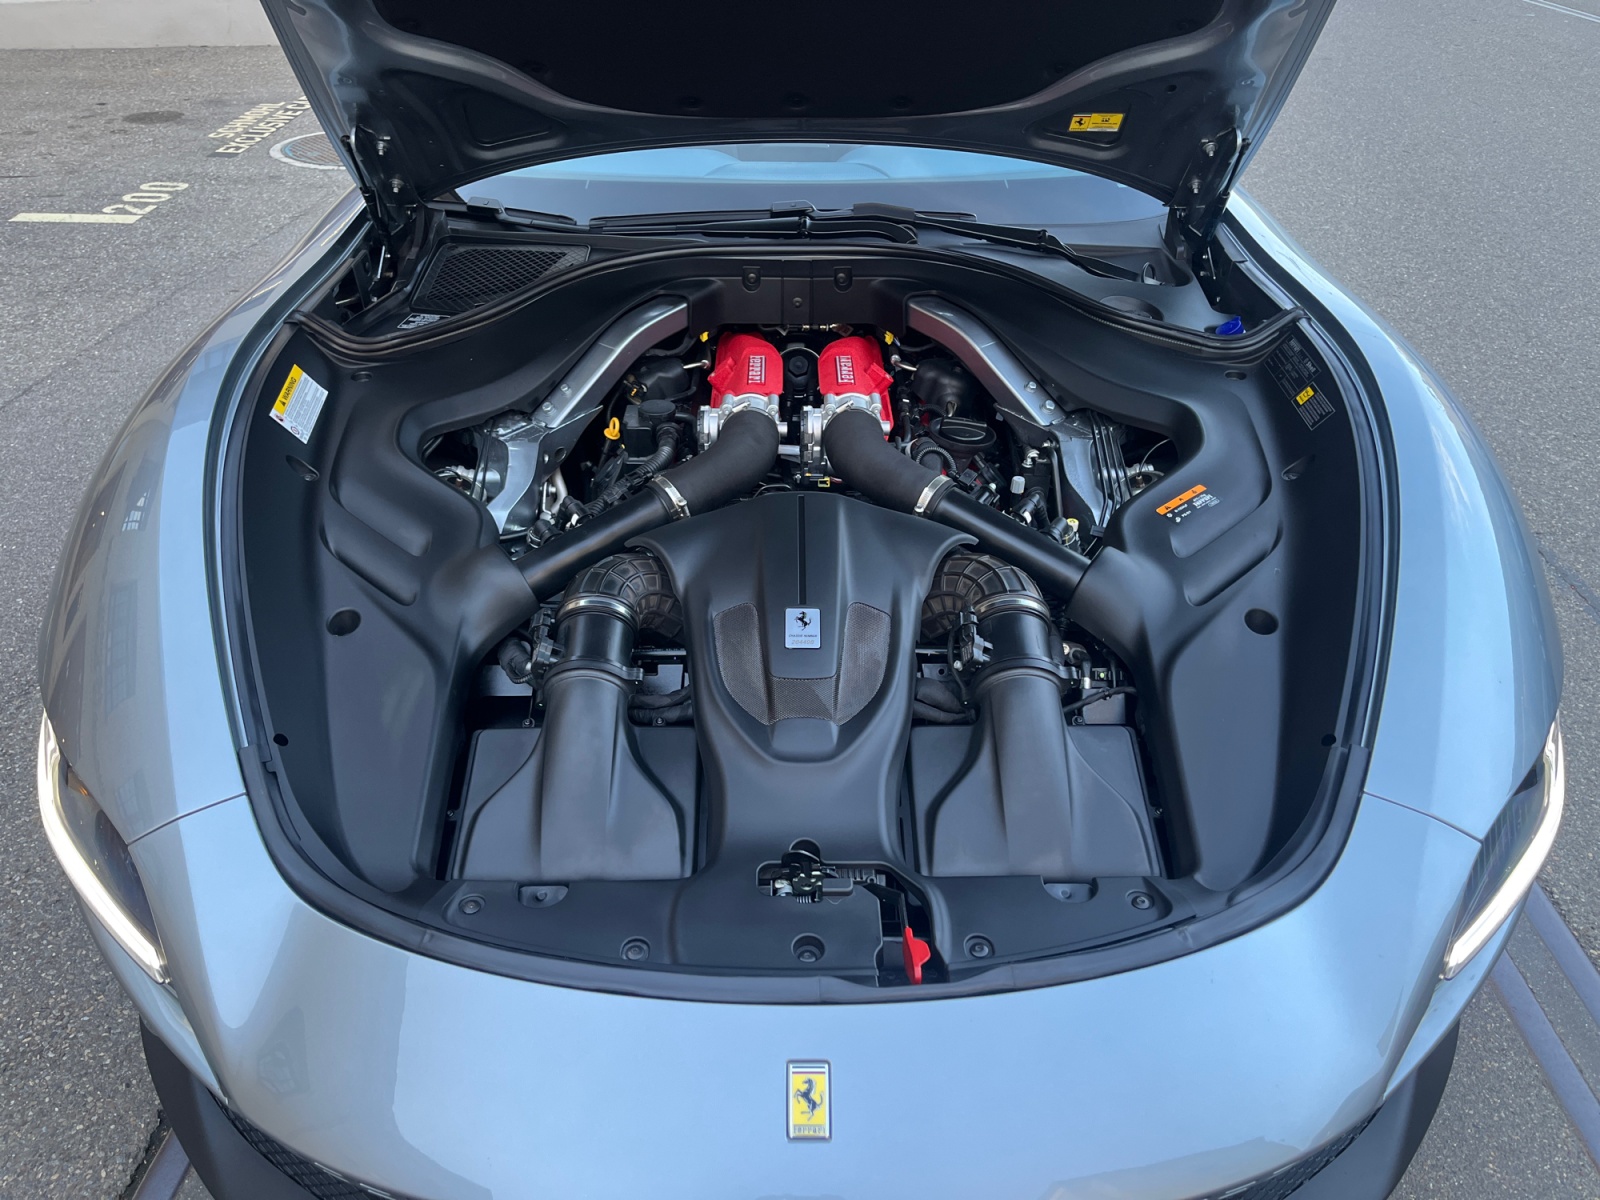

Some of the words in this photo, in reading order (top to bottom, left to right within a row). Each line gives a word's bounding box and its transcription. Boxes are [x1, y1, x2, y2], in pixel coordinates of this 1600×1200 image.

[215, 110, 303, 153] EXCLUSIVE
[102, 182, 188, 214] 200
[748, 356, 765, 383] Ferrari
[836, 356, 854, 383] Ferrari
[281, 376, 297, 400] WARNING
